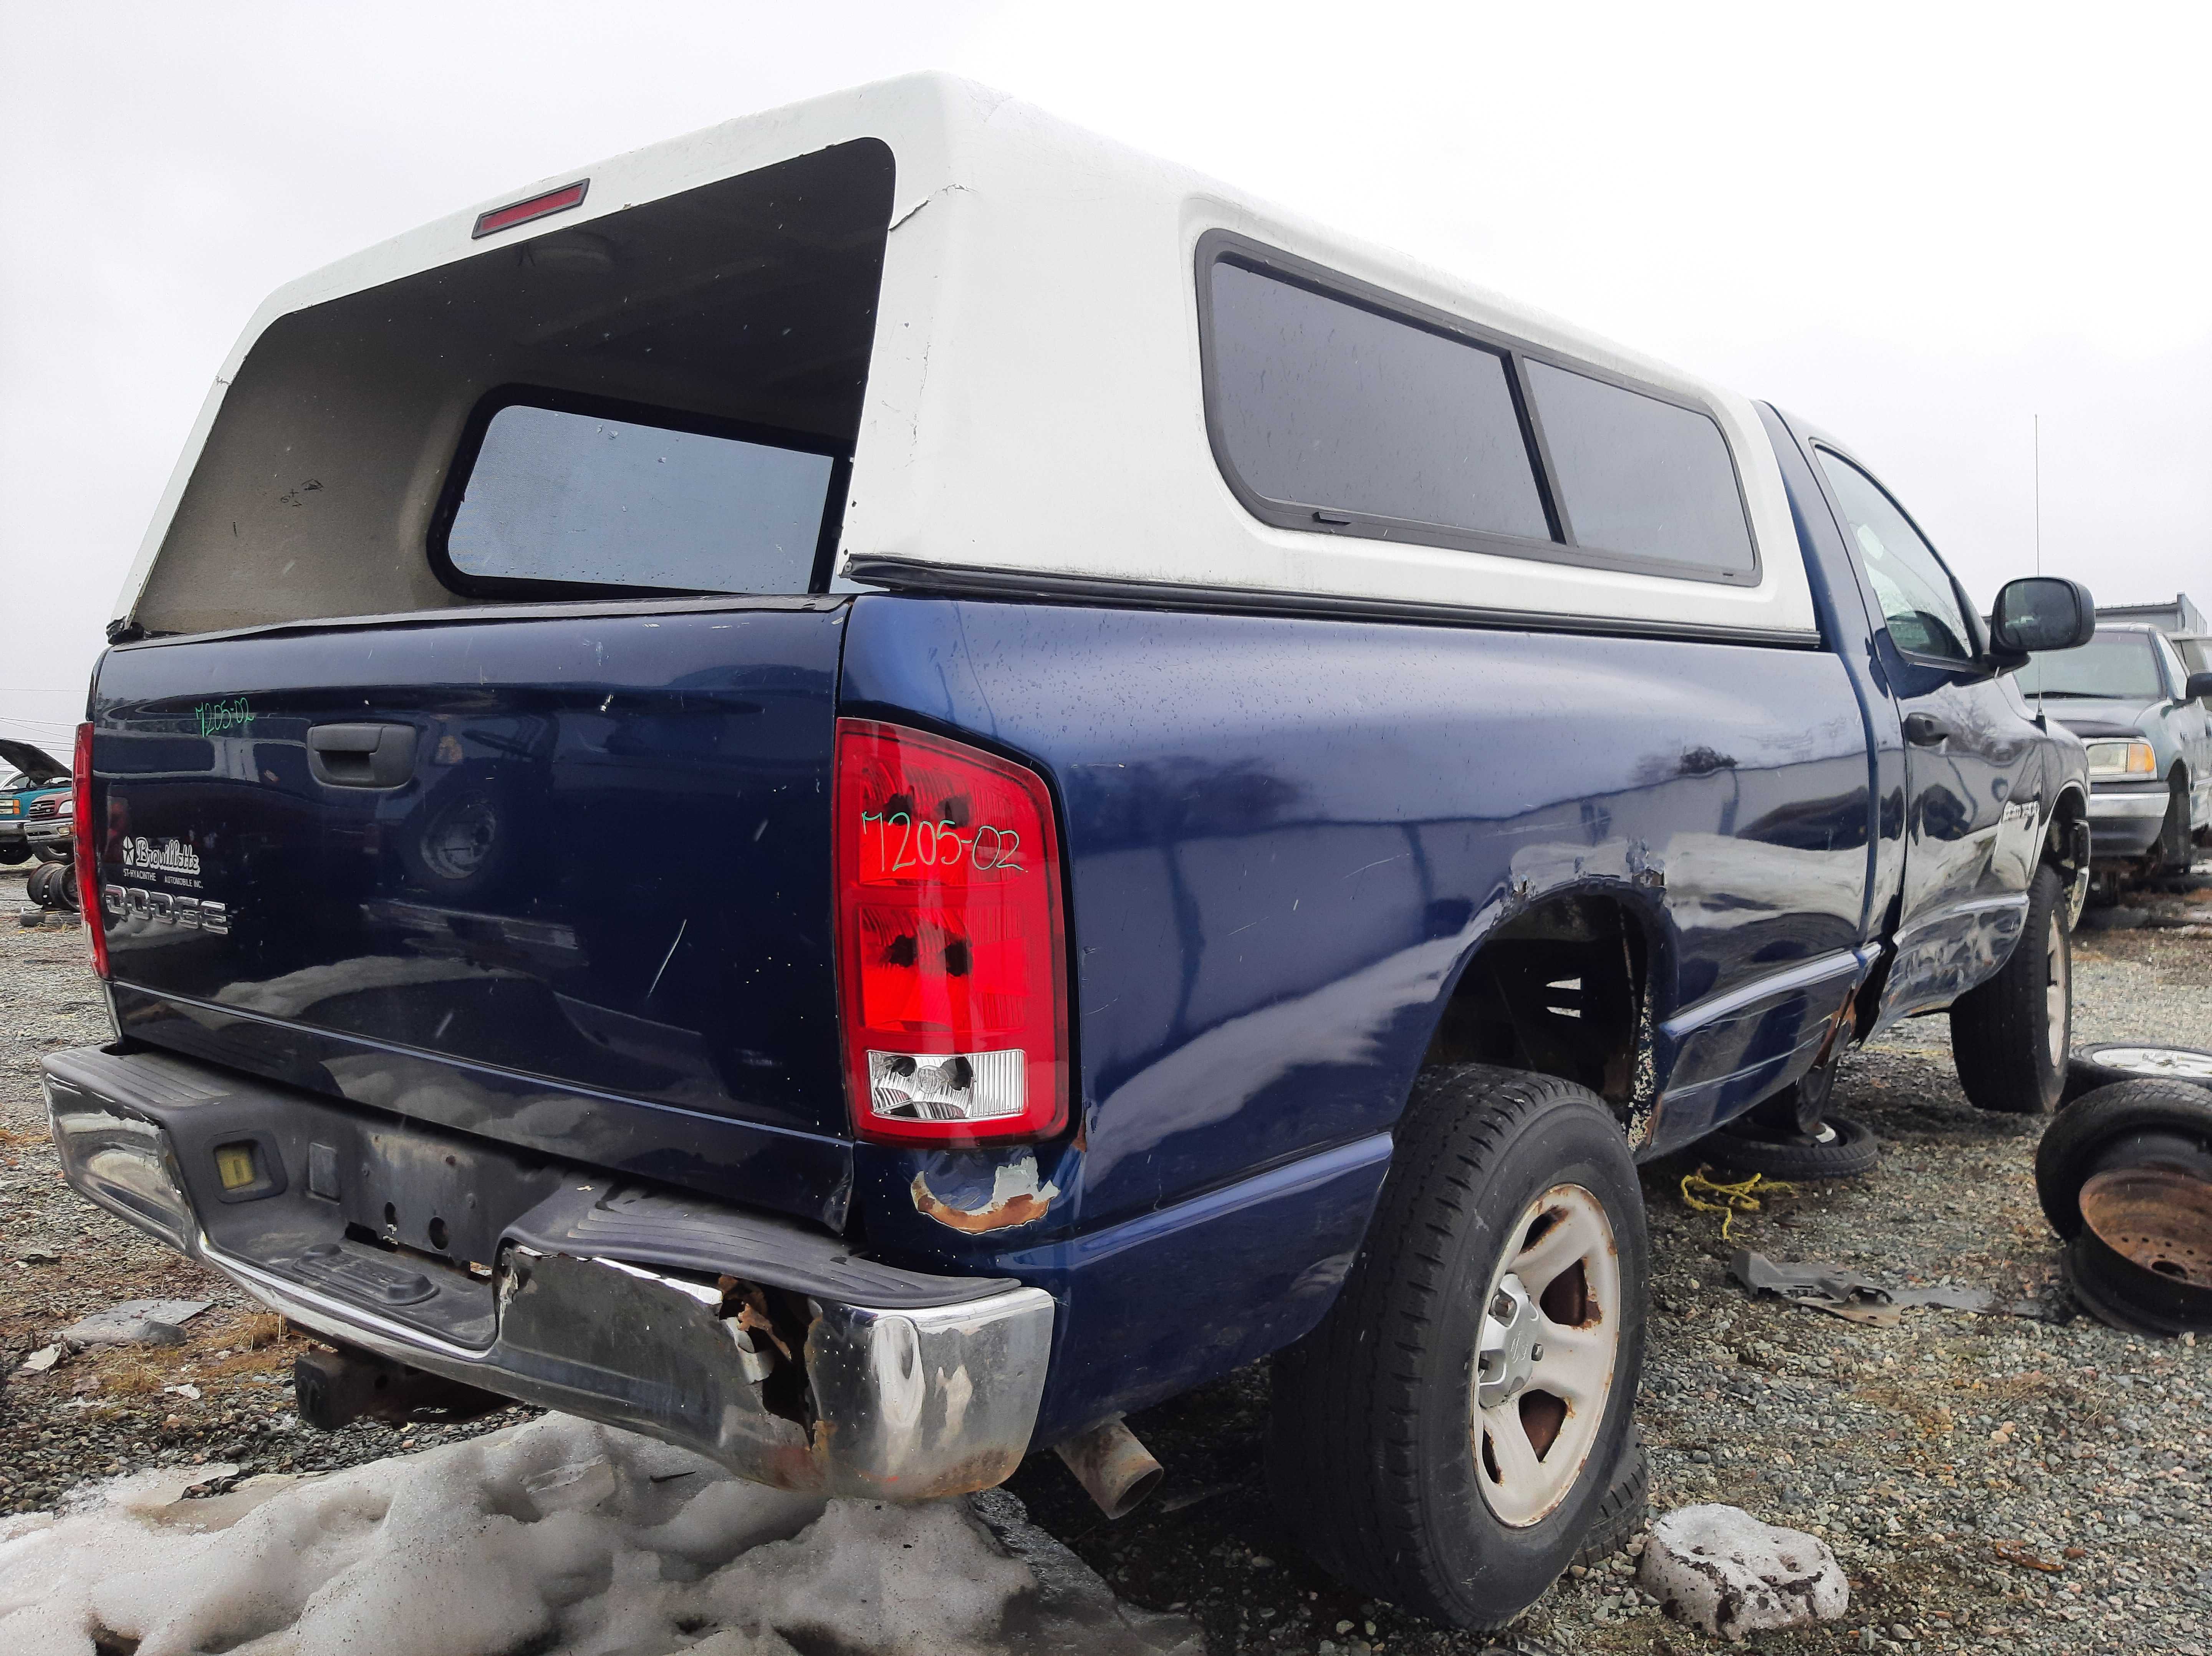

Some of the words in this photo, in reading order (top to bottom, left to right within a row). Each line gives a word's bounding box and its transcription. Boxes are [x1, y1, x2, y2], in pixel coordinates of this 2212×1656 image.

[136, 836, 200, 875] Brouillette
[123, 868, 157, 881] ST-HYACINTHE
[164, 875, 193, 888] AUTOMOBILE
[103, 884, 230, 935] DODGE
